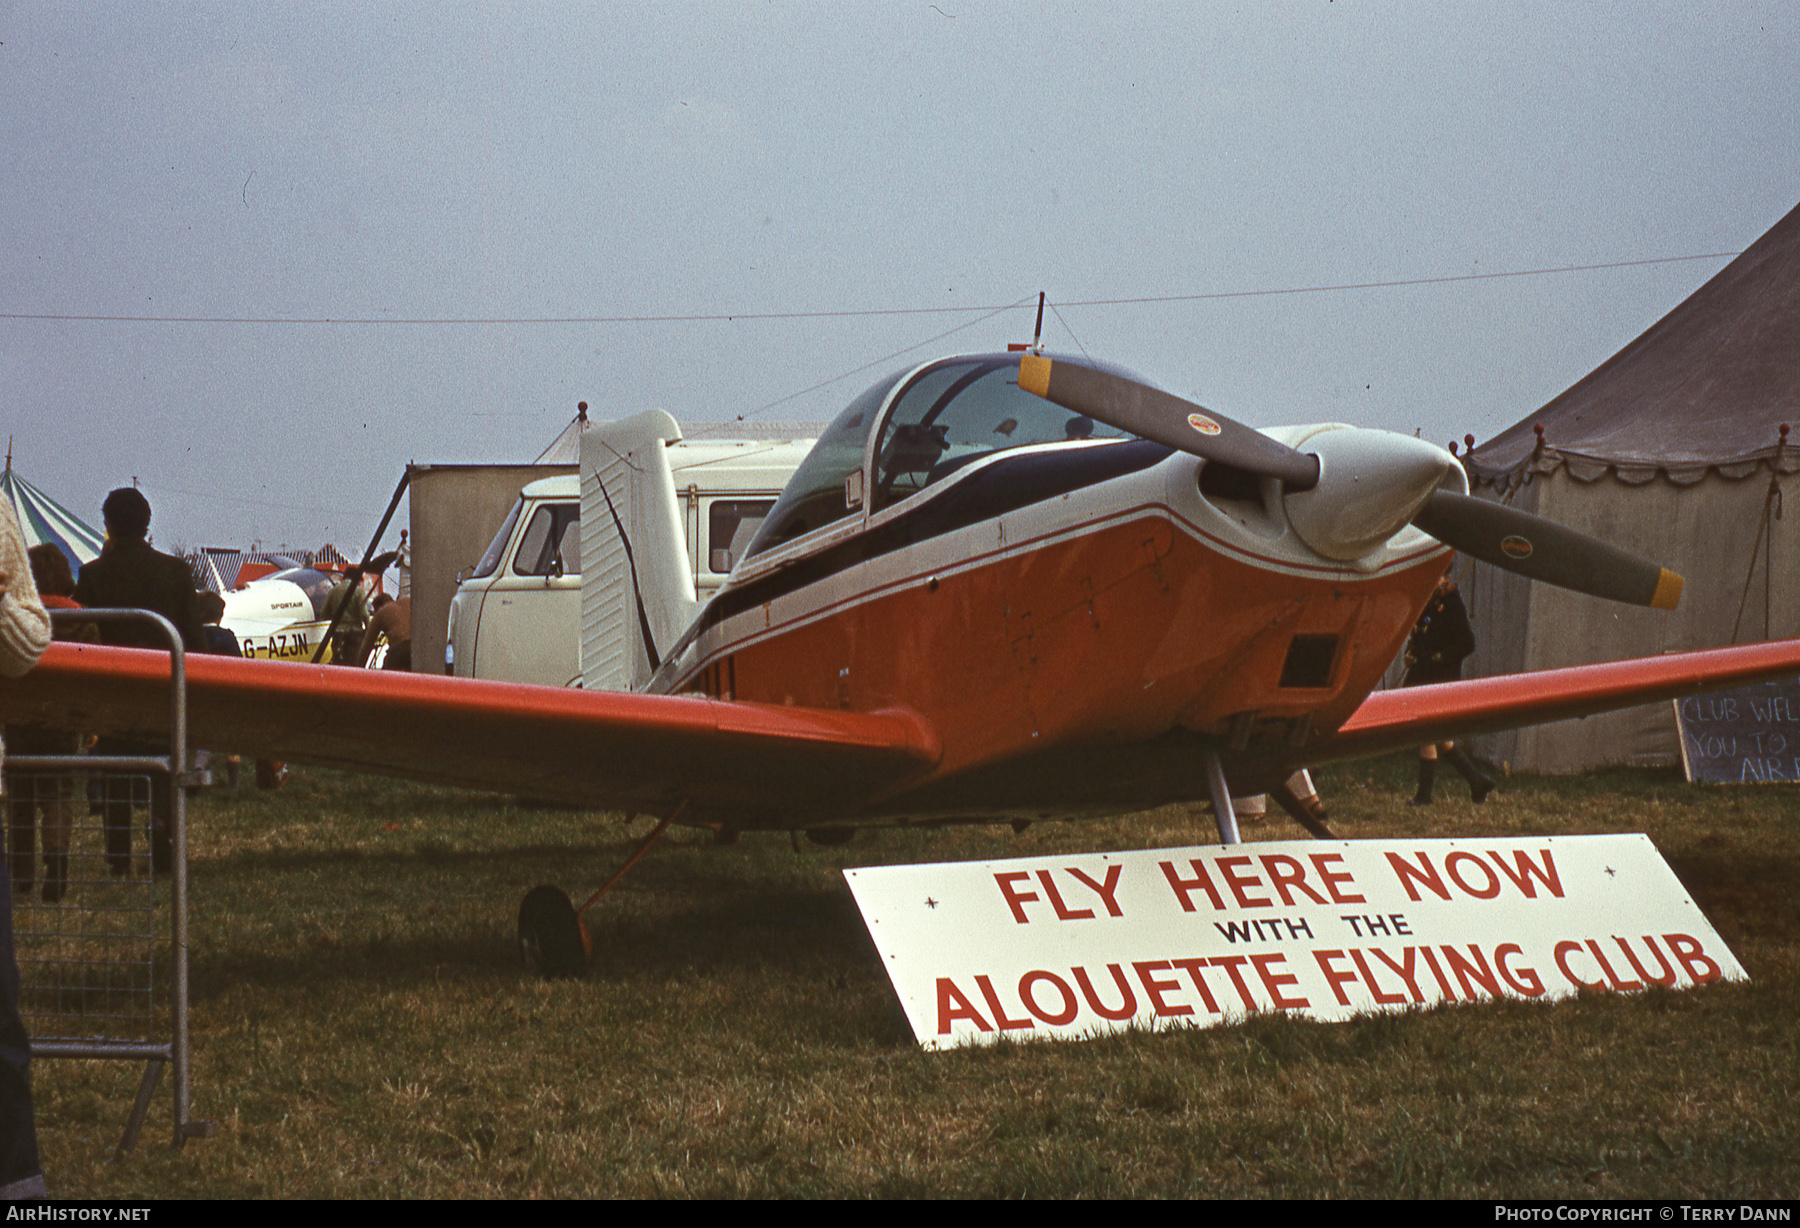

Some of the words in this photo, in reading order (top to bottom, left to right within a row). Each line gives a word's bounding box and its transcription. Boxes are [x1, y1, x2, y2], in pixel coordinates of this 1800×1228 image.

[271, 602, 303, 610] SPORTAIR
[243, 633, 308, 659] G-AZJN
[1682, 697, 1739, 722] CLUB
[1749, 697, 1800, 722] WEL
[1689, 732, 1736, 758] YOU
[1748, 731, 1786, 754] TO
[1741, 757, 1784, 781] AIR
[993, 864, 1124, 924] FLY
[1157, 853, 1367, 913] HERE
[1383, 849, 1566, 902] NOW
[1213, 917, 1315, 944] WITH
[1340, 913, 1413, 938] THE
[935, 952, 1311, 1035] ALOUETTE
[1311, 943, 1546, 1007] FLYING
[1553, 933, 1723, 992] CLUB
